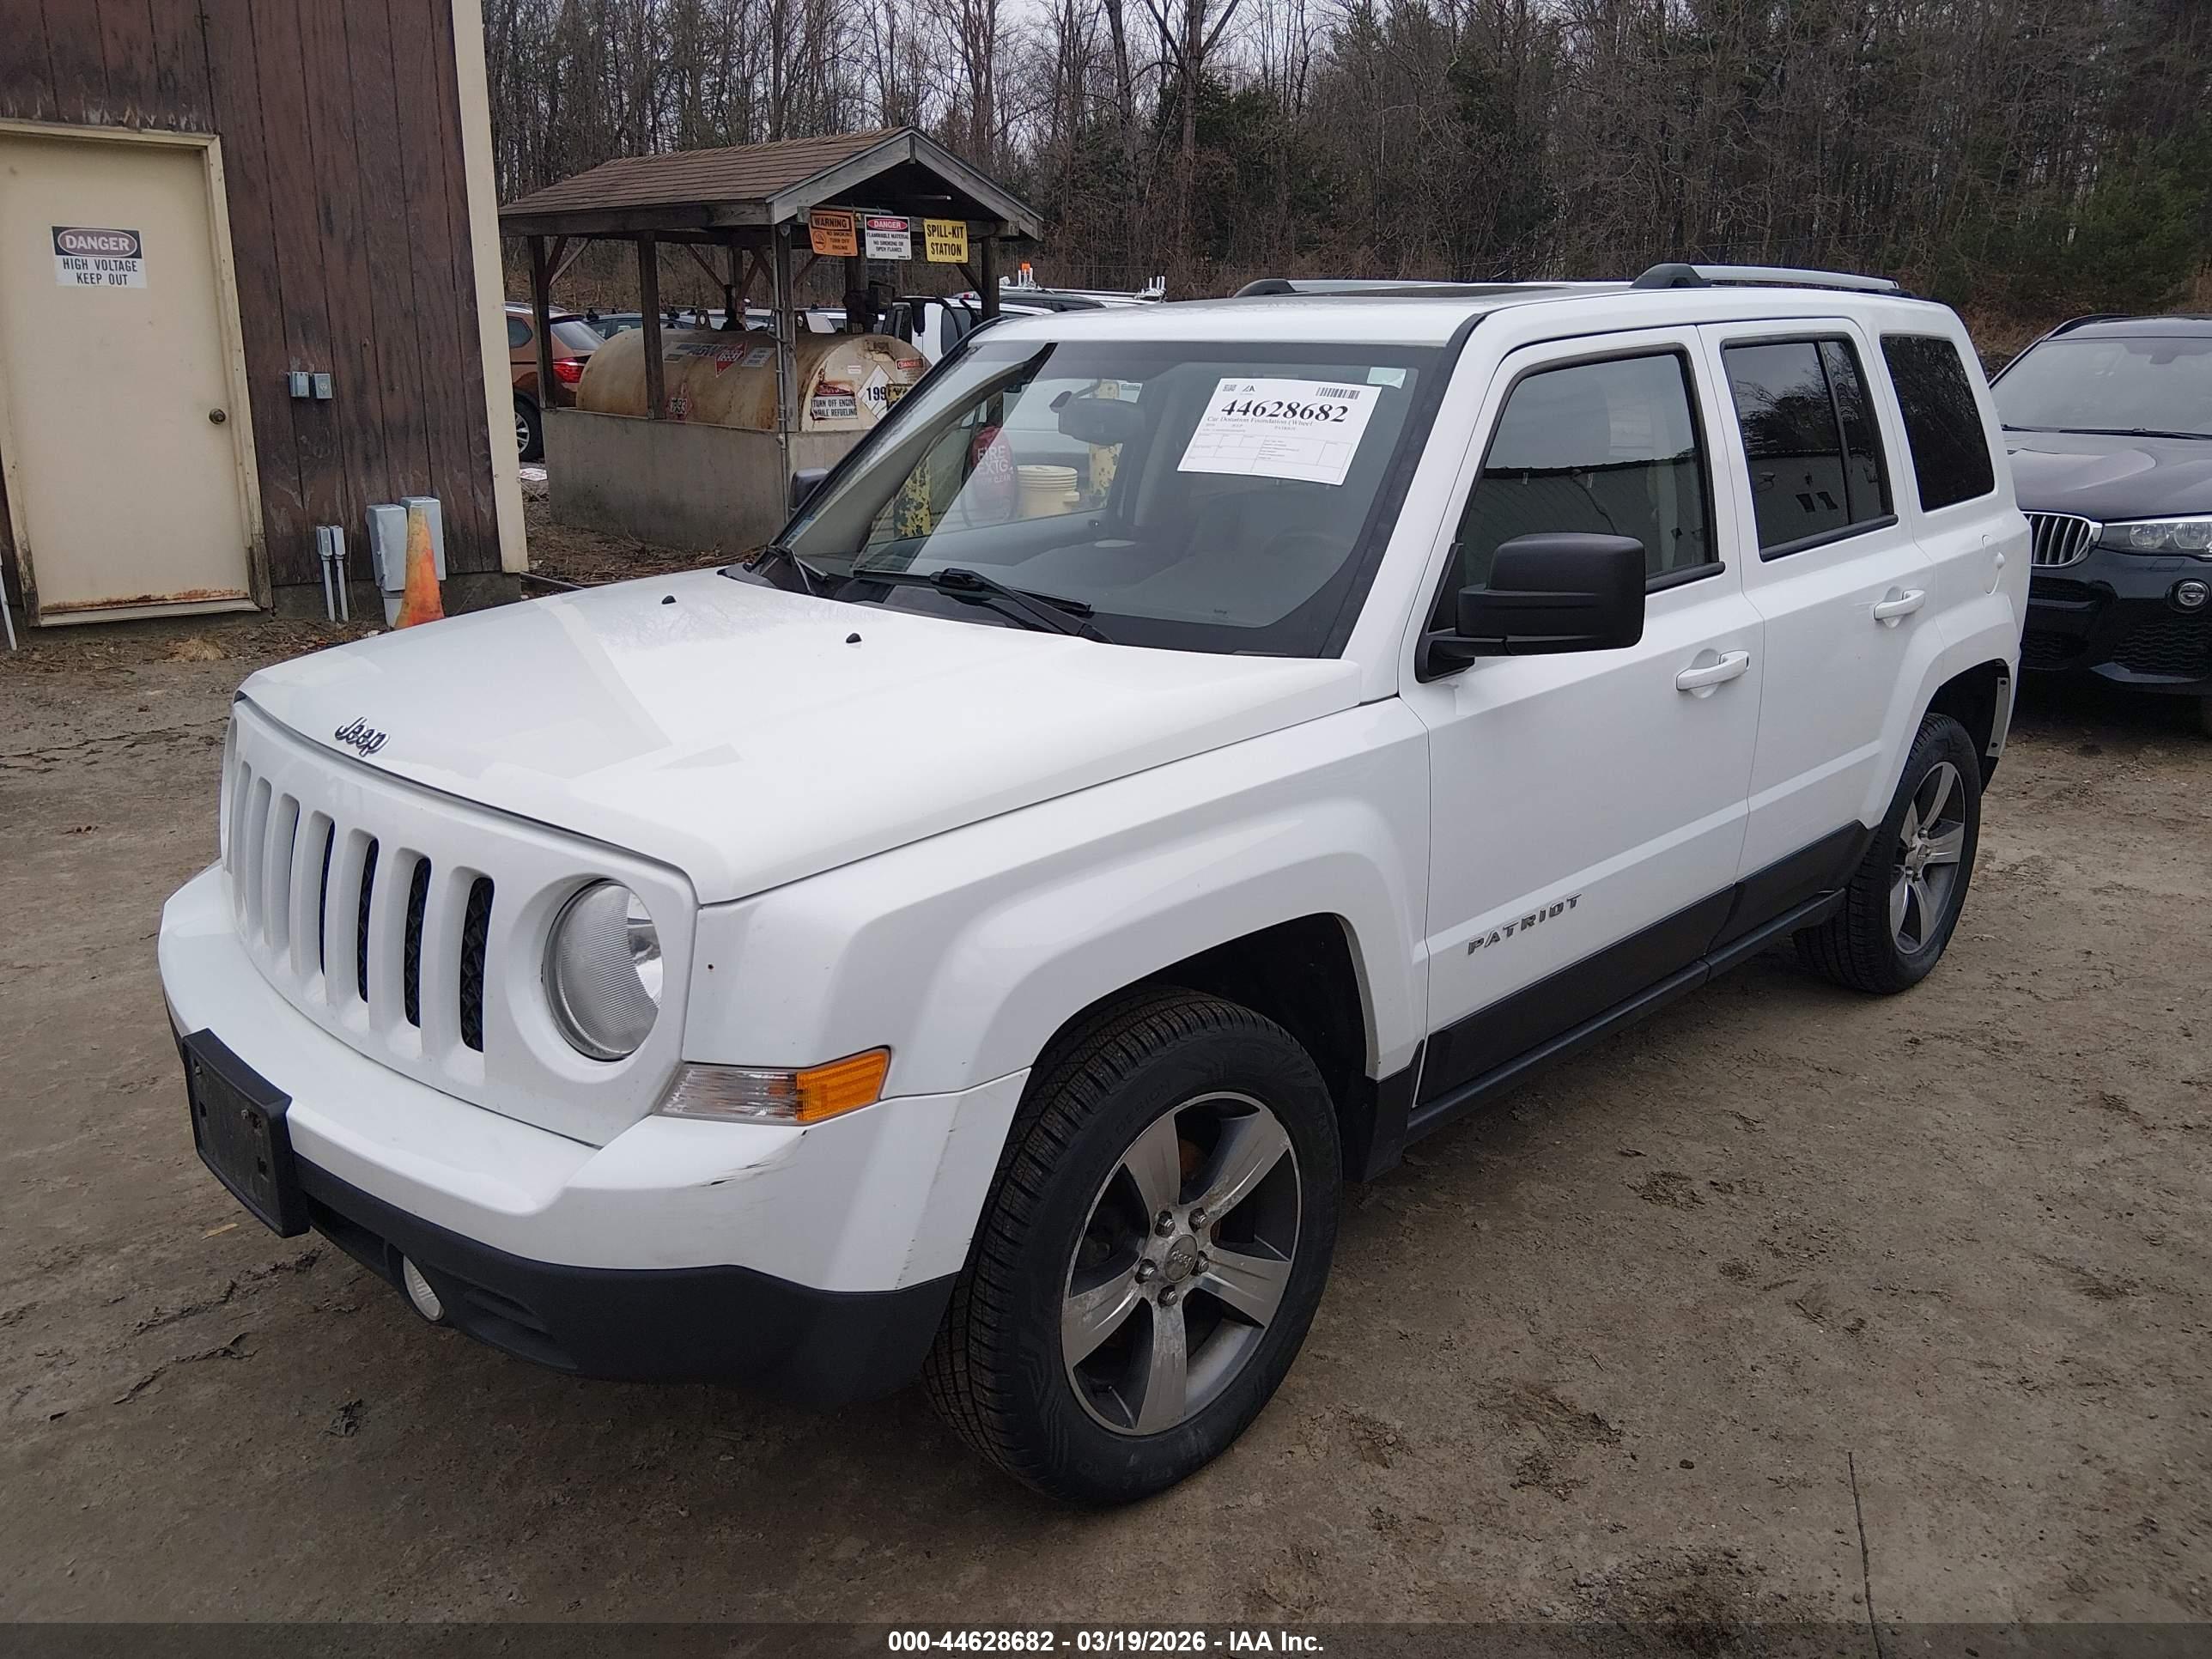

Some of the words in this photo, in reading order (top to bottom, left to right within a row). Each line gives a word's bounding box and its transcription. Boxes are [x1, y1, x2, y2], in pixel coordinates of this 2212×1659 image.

[814, 215, 848, 228] WARNING
[873, 221, 901, 229] DANGER
[927, 223, 964, 239] SPILL-KIT
[64, 234, 131, 251] DANGER
[931, 241, 962, 257] STATION
[63, 258, 89, 270] HIGH
[94, 259, 138, 272] VOLTAGE
[76, 272, 103, 285] KEEP
[108, 274, 129, 286] OUT
[866, 386, 887, 401] 199
[812, 398, 827, 407] TURN
[828, 398, 837, 407] OFF
[1221, 399, 1348, 422] 44628682
[977, 446, 1006, 460] FIRE
[334, 716, 390, 757] Jeep
[1468, 893, 1582, 955] PATRIOT
